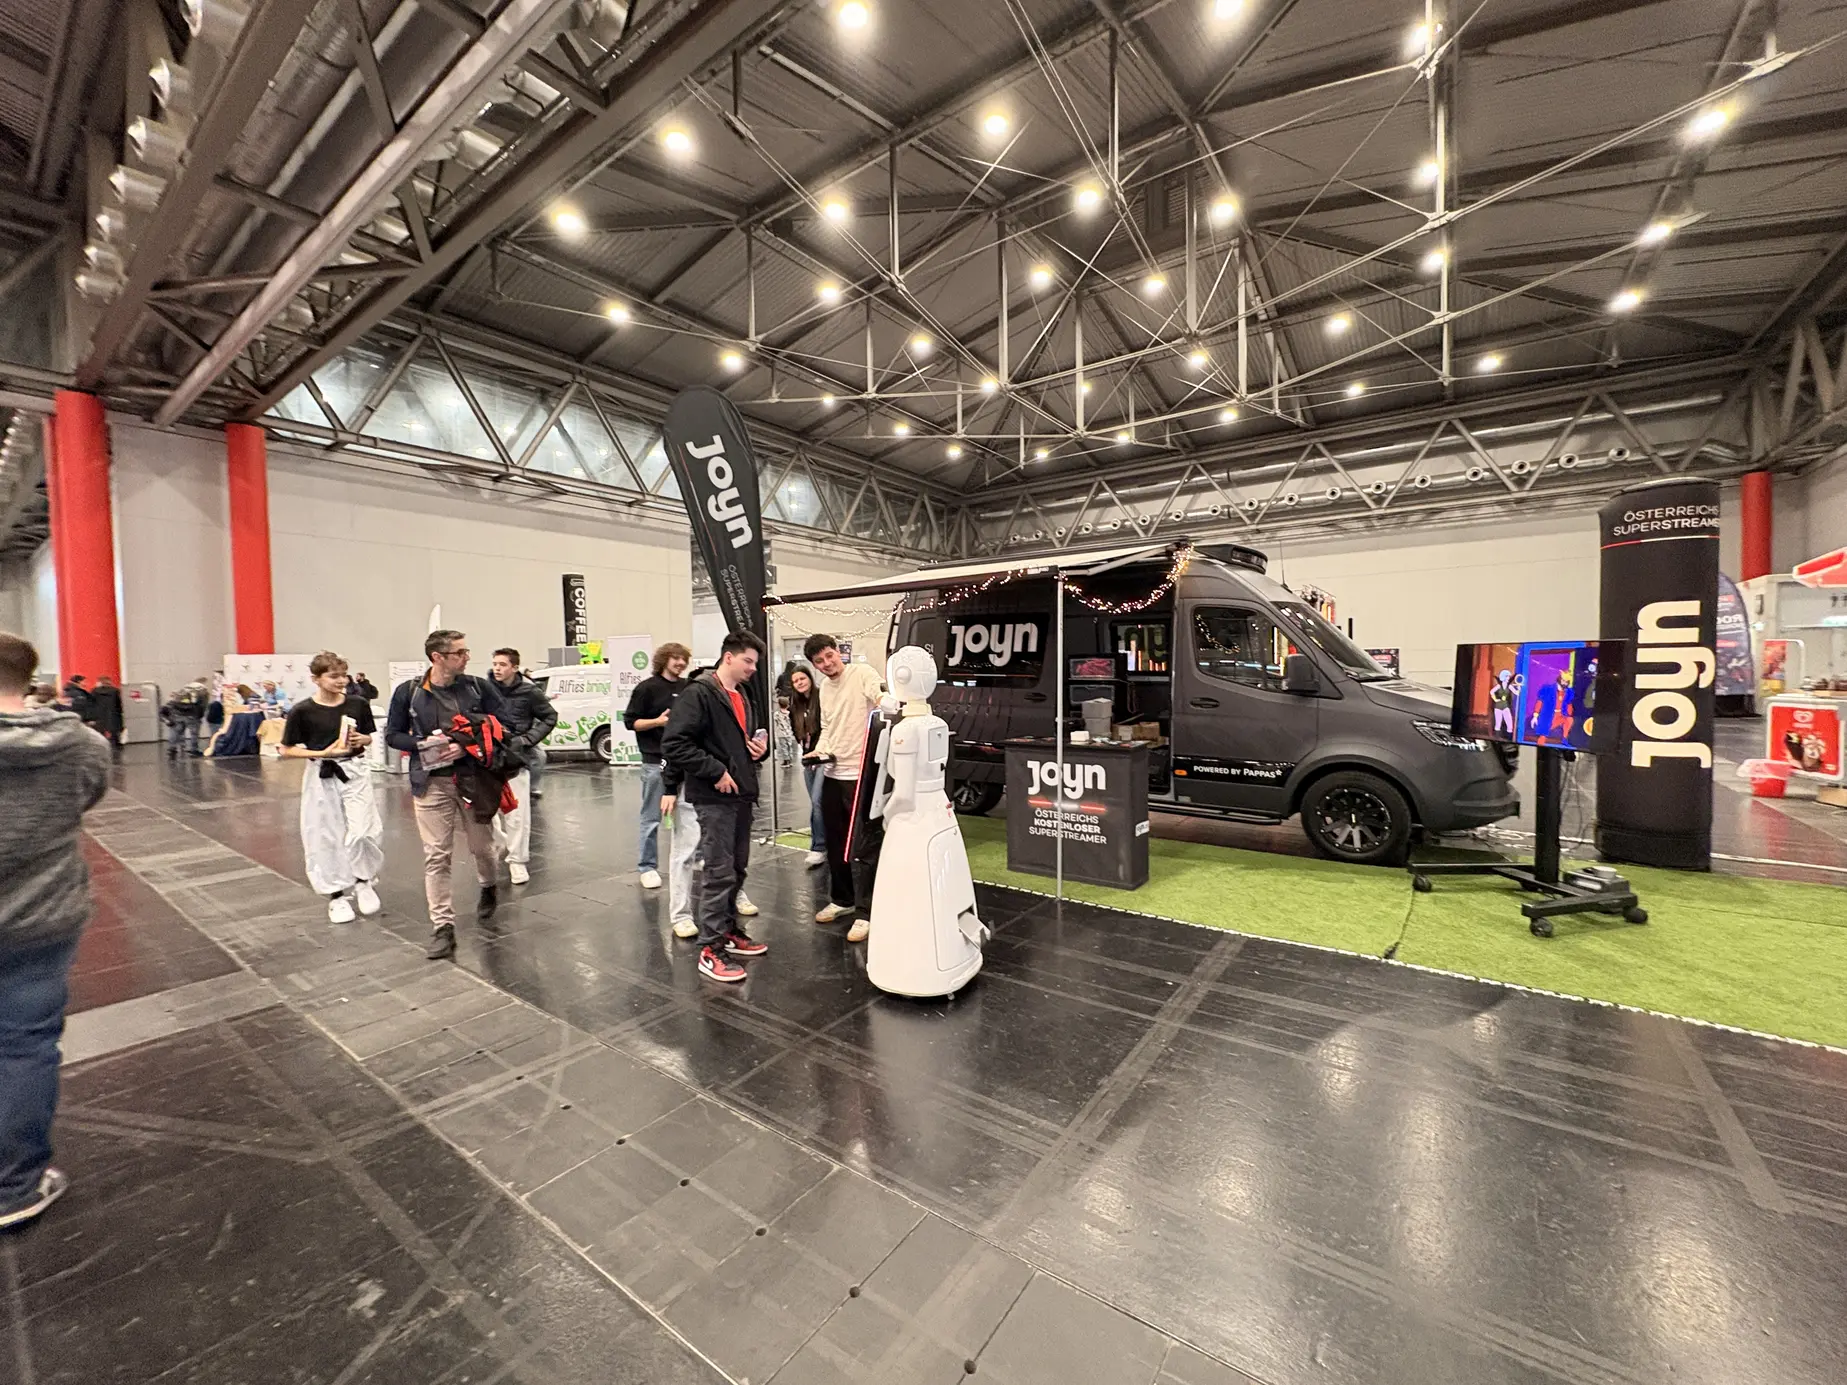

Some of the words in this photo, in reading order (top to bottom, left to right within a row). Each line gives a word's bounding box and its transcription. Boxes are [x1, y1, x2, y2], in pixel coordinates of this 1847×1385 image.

[1613, 517, 1720, 536] SUPERSTREAME
[574, 587, 587, 646] COFFEE
[947, 622, 1039, 667] joyn
[559, 679, 585, 693] Alfies
[1631, 600, 1716, 768] joyn
[1193, 765, 1230, 775] POWERED
[1230, 767, 1242, 776] BY
[1027, 760, 1106, 800] joyn
[1034, 807, 1099, 824] ÖSTERREICHS
[1033, 817, 1102, 834] KOSTENLOSER
[1028, 826, 1107, 844] SUPERSTREAMER
